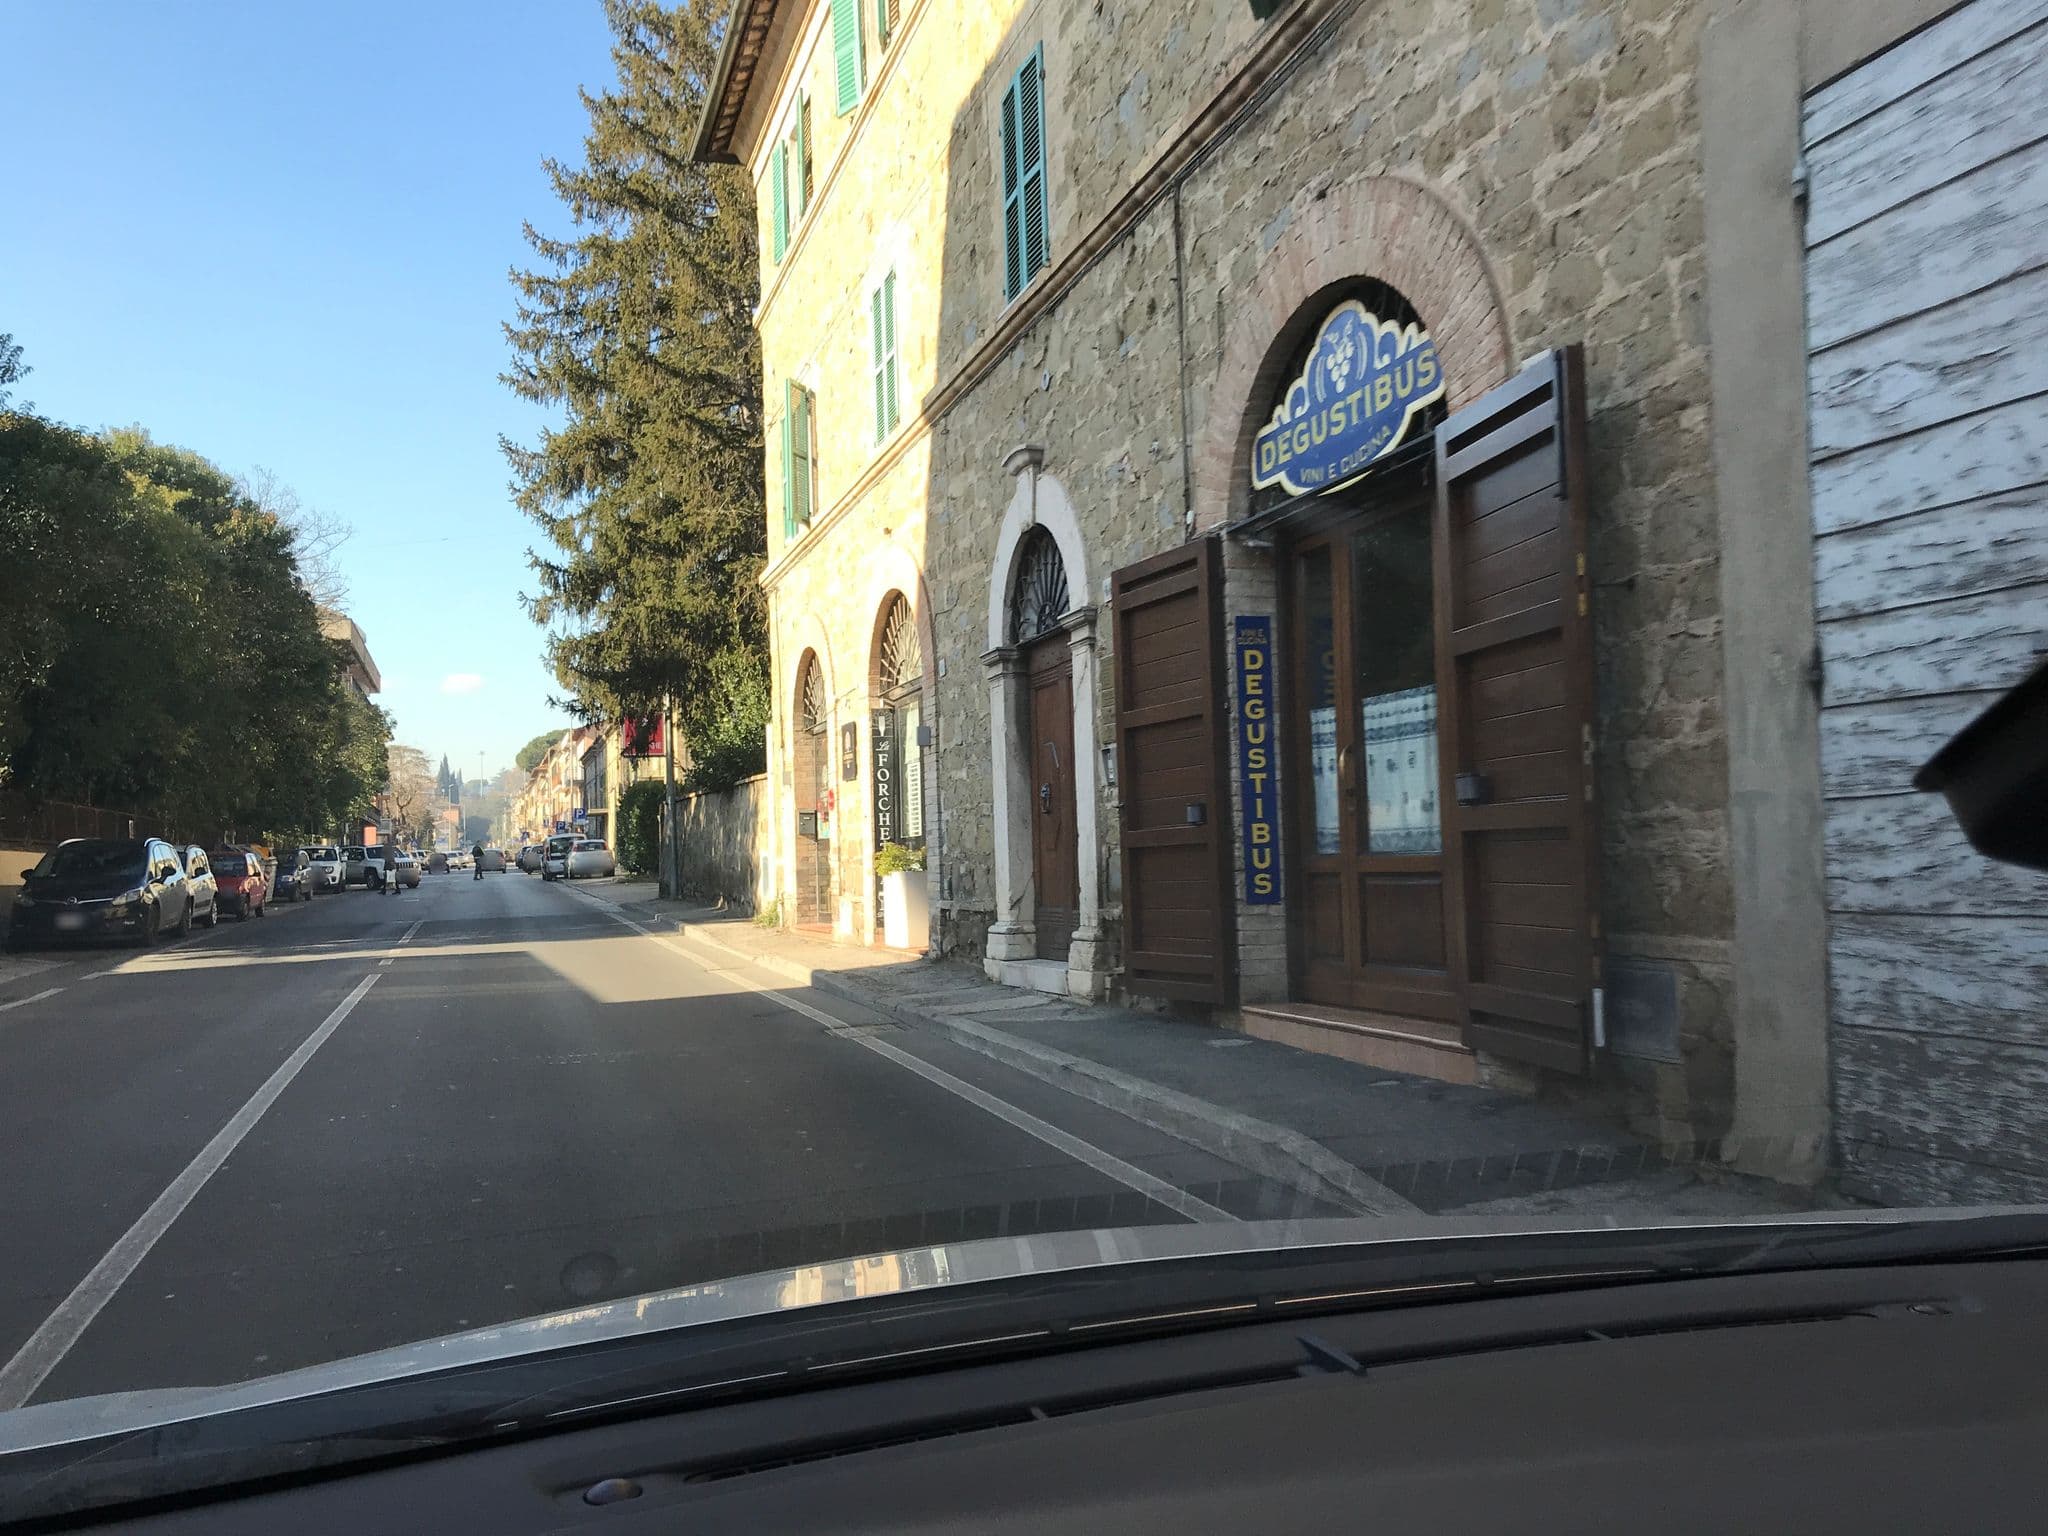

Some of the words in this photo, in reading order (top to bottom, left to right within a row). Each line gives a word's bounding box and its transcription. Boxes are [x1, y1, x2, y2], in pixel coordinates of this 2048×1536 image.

[1261, 348, 1437, 474] DEGUSTIBUS
[1300, 467, 1324, 483] VINI
[1328, 462, 1337, 479] E
[1243, 649, 1273, 895] DEGUSTIBUS
[576, 809, 584, 818] P
